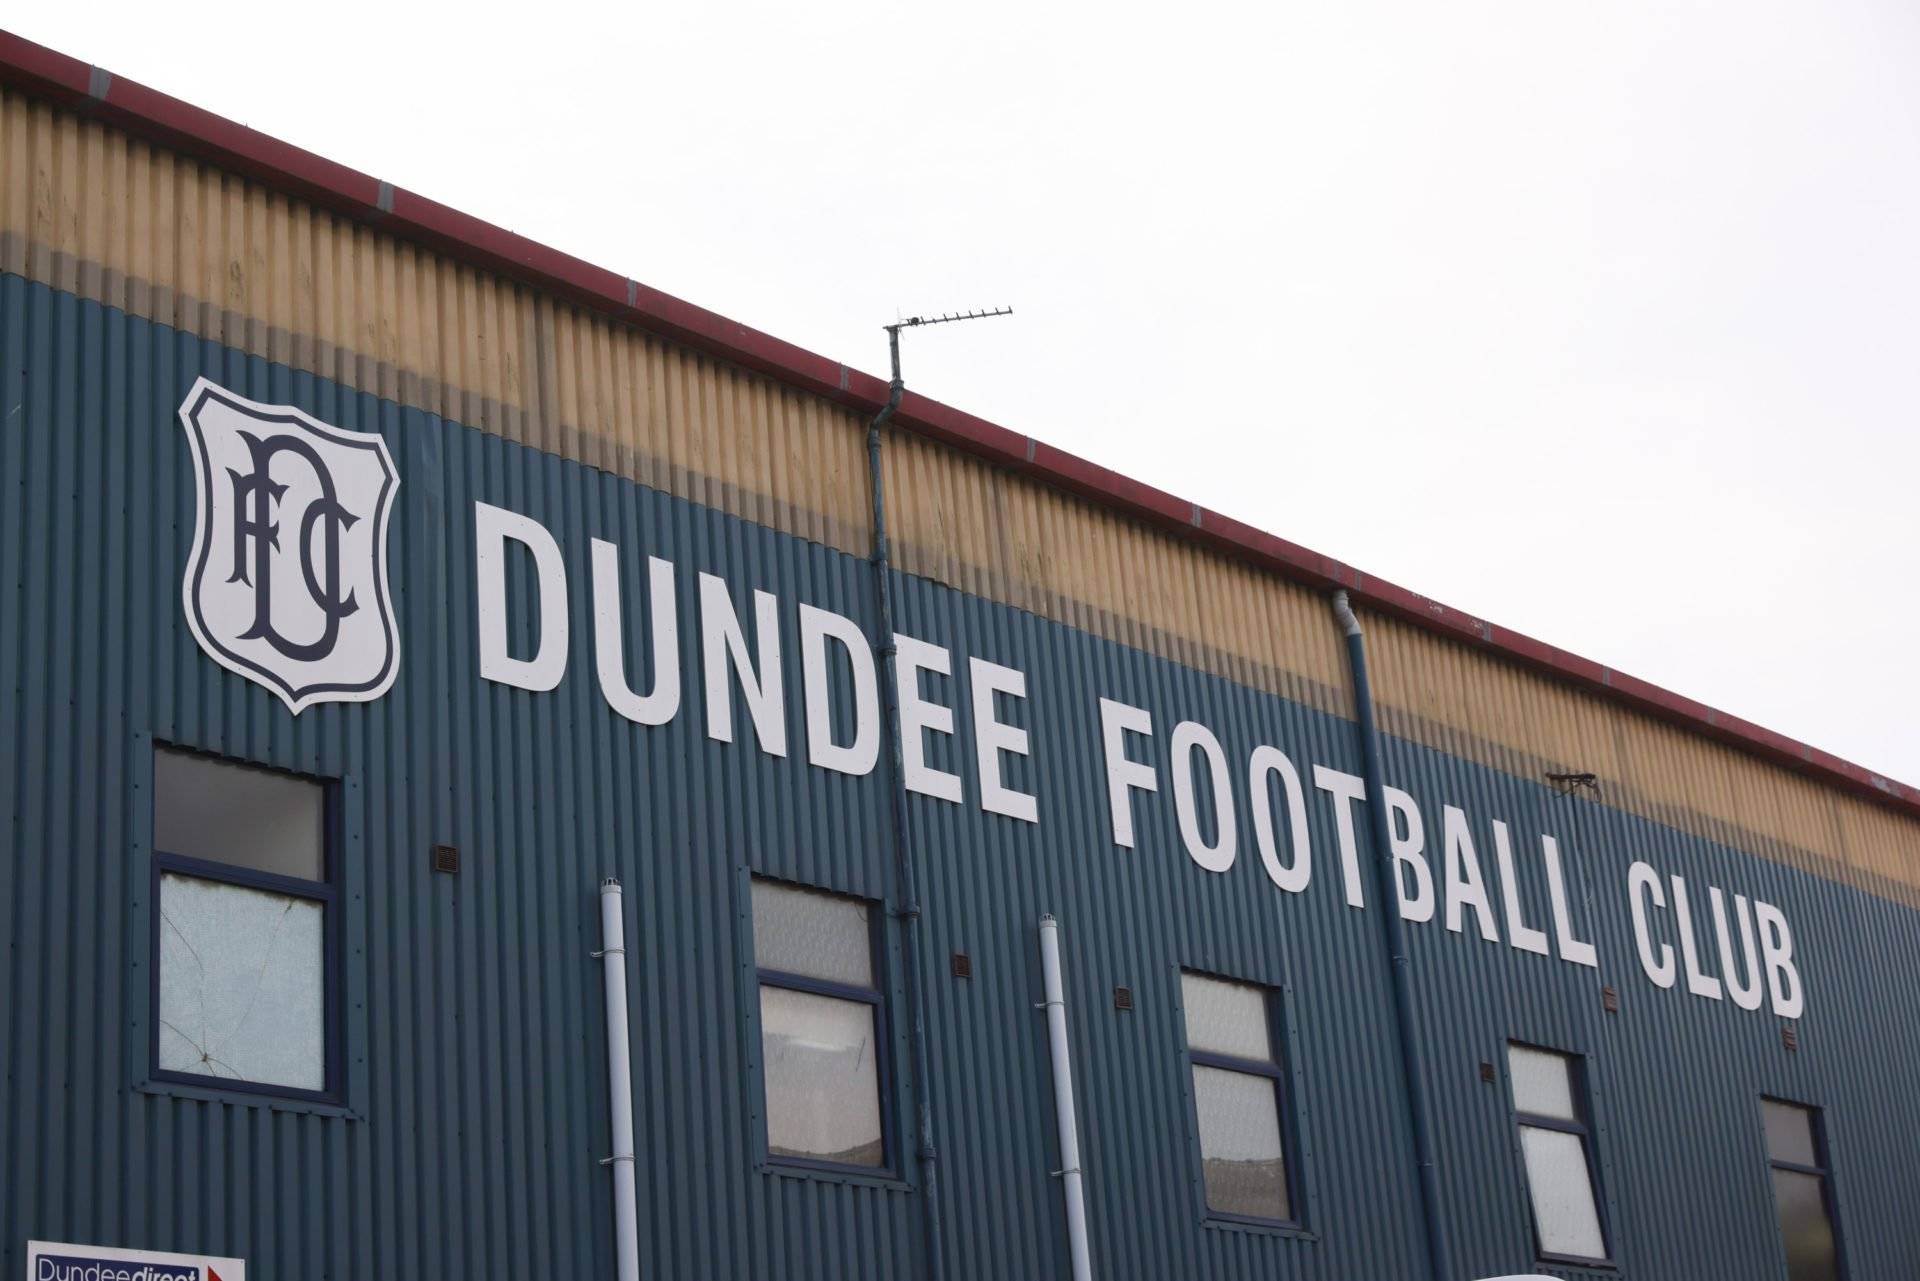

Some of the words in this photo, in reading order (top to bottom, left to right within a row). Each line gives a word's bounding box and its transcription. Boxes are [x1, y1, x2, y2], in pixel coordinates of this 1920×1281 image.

[475, 500, 1040, 824] DUNDEE
[1099, 697, 1598, 968] FOOTBALL
[1628, 861, 1804, 1020] CLUB
